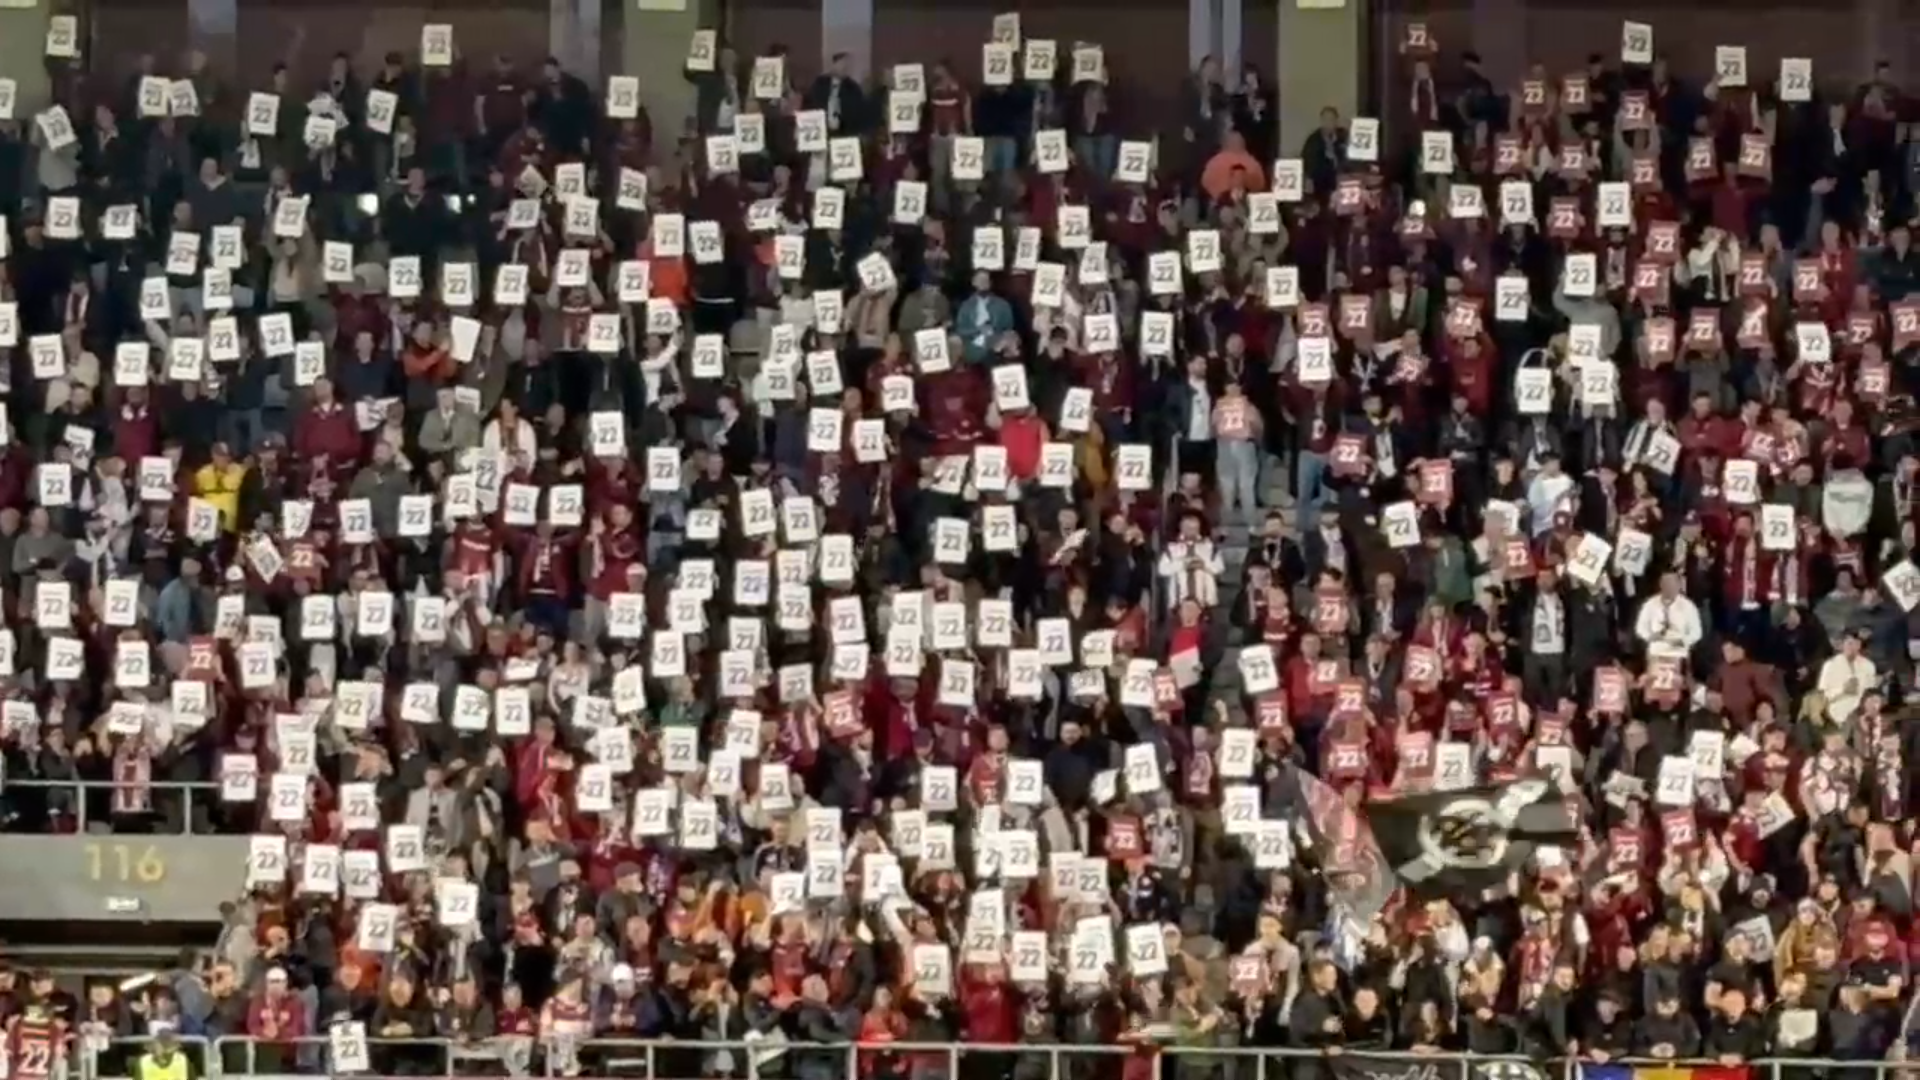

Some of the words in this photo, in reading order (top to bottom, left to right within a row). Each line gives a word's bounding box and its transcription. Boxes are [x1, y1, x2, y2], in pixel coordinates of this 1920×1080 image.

[988, 58, 1006, 73] 22
[1031, 53, 1049, 69] 22
[1786, 73, 1804, 89] 22
[1524, 86, 1543, 104] 22
[253, 106, 273, 124] 22
[895, 105, 913, 120] 22
[740, 126, 758, 143] 22
[1429, 146, 1446, 161] 22
[1124, 155, 1143, 172] 22
[1634, 165, 1653, 183] 22
[819, 201, 837, 217] 22
[900, 195, 920, 213] 22
[1507, 197, 1527, 212] 22
[53, 211, 73, 228] 22
[1555, 211, 1573, 226] 22
[217, 240, 235, 256] 22
[980, 242, 997, 258] 22
[1195, 243, 1213, 260] 22
[564, 259, 582, 274] 22
[1743, 266, 1762, 284] 22
[502, 276, 520, 292] 22
[624, 274, 644, 290] 22
[1571, 268, 1589, 284] 22
[448, 278, 466, 294] 22
[1039, 278, 1057, 294] 22
[1273, 279, 1291, 295] 22
[1897, 314, 1916, 332] 22
[1147, 326, 1167, 344] 22
[38, 348, 56, 367] 22
[123, 357, 141, 373] 22
[1305, 351, 1324, 369] 22
[768, 376, 788, 390] 22
[814, 366, 833, 383] 22
[1525, 383, 1544, 401] 22
[598, 426, 617, 444] 22
[1339, 445, 1358, 462] 22
[654, 462, 674, 478] 22
[981, 461, 1001, 477] 22
[1125, 461, 1143, 477] 22
[45, 479, 65, 495] 22
[406, 510, 424, 524] 22
[749, 505, 767, 523] 22
[790, 512, 809, 529] 22
[347, 514, 366, 532] 22
[1769, 521, 1789, 537] 22
[942, 533, 962, 551] 22
[293, 550, 313, 566] 22
[827, 550, 847, 568] 22
[687, 572, 707, 588] 22
[742, 576, 762, 592] 22
[43, 598, 63, 614] 22
[111, 594, 130, 613] 22
[677, 602, 695, 621] 22
[365, 605, 385, 624] 22
[616, 607, 636, 625] 22
[986, 616, 1006, 632] 22
[191, 651, 211, 667] 22
[894, 645, 914, 663] 22
[248, 657, 267, 675] 22
[948, 675, 967, 693] 22
[1340, 692, 1360, 710] 22
[504, 704, 522, 722] 22
[1261, 707, 1282, 726] 22
[288, 746, 308, 764] 22
[605, 742, 624, 761] 22
[670, 744, 690, 760] 22
[1227, 744, 1247, 763] 22
[1015, 775, 1035, 791] 22
[279, 789, 299, 807] 22
[643, 804, 661, 822] 22
[690, 818, 710, 836] 22
[396, 841, 417, 858] 22
[1262, 837, 1282, 855] 22
[85, 843, 164, 882] 116
[1011, 846, 1031, 864] 22
[311, 860, 331, 879] 22
[449, 896, 469, 912] 22
[1019, 949, 1039, 967] 22
[1077, 951, 1097, 970] 22
[18, 1039, 51, 1074] 22
[340, 1039, 359, 1058] 22
